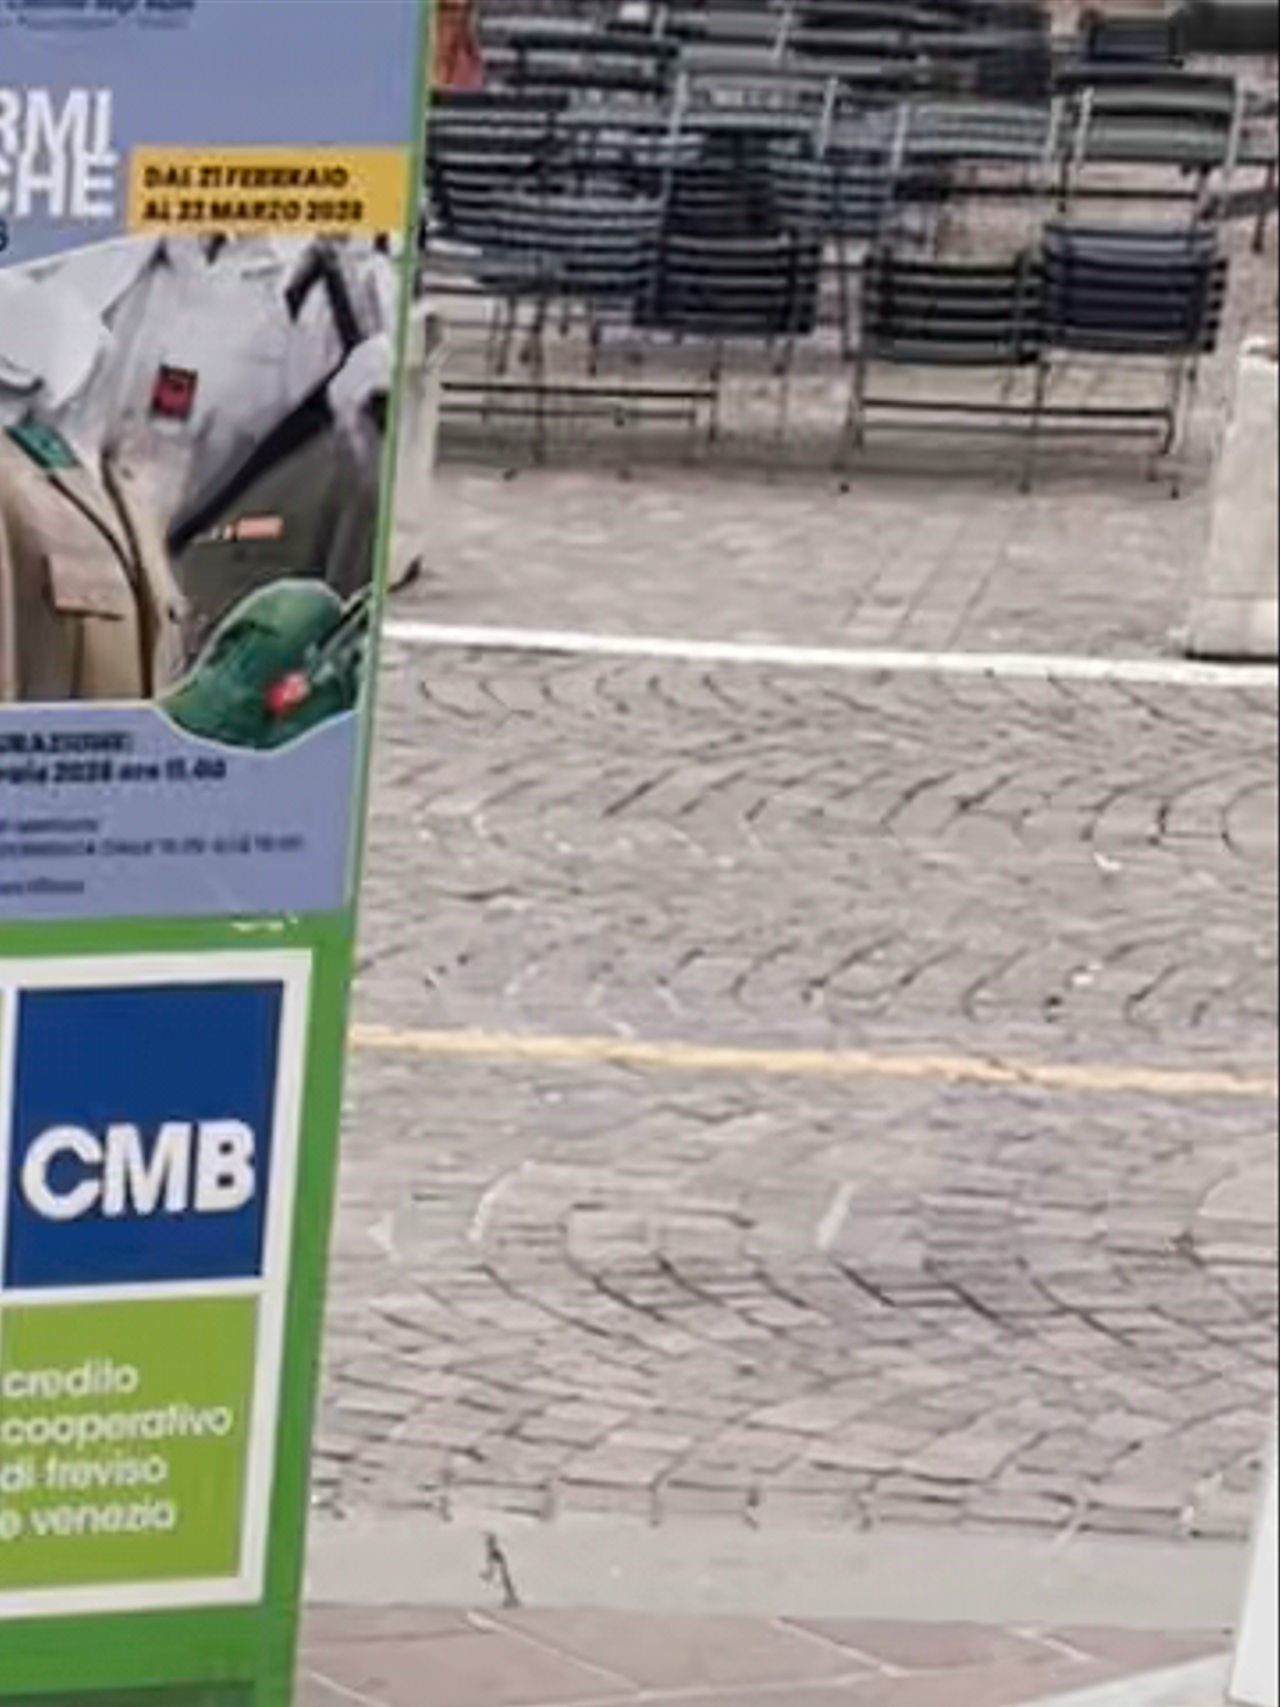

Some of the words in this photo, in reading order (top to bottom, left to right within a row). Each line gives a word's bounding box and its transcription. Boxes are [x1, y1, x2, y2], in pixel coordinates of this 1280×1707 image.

[209, 198, 302, 221] MARZO
[21, 1118, 256, 1221] CMB
[2, 1356, 140, 1398] credito
[1, 1402, 234, 1450] cooperativo
[45, 1450, 169, 1490] treviso
[30, 1494, 176, 1536] venezia
